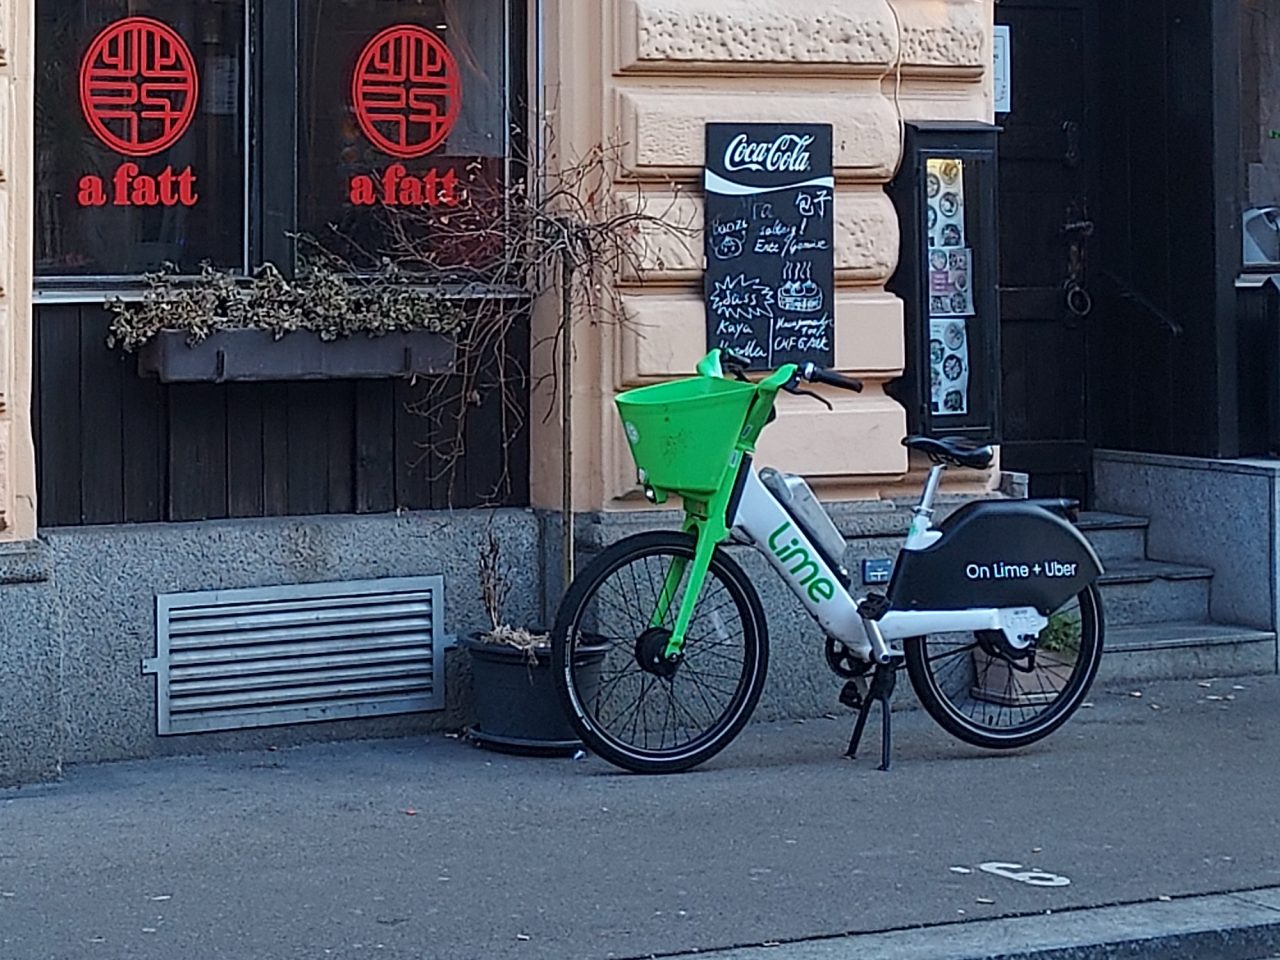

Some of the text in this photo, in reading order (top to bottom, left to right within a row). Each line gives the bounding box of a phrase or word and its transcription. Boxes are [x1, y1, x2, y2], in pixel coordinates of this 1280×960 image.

[724, 134, 814, 171] Coca-Cola
[78, 162, 198, 206] a fatt
[350, 165, 459, 206] a fatt
[966, 564, 990, 579] On
[993, 562, 1029, 578] Lime
[1044, 561, 1077, 577] Uber
